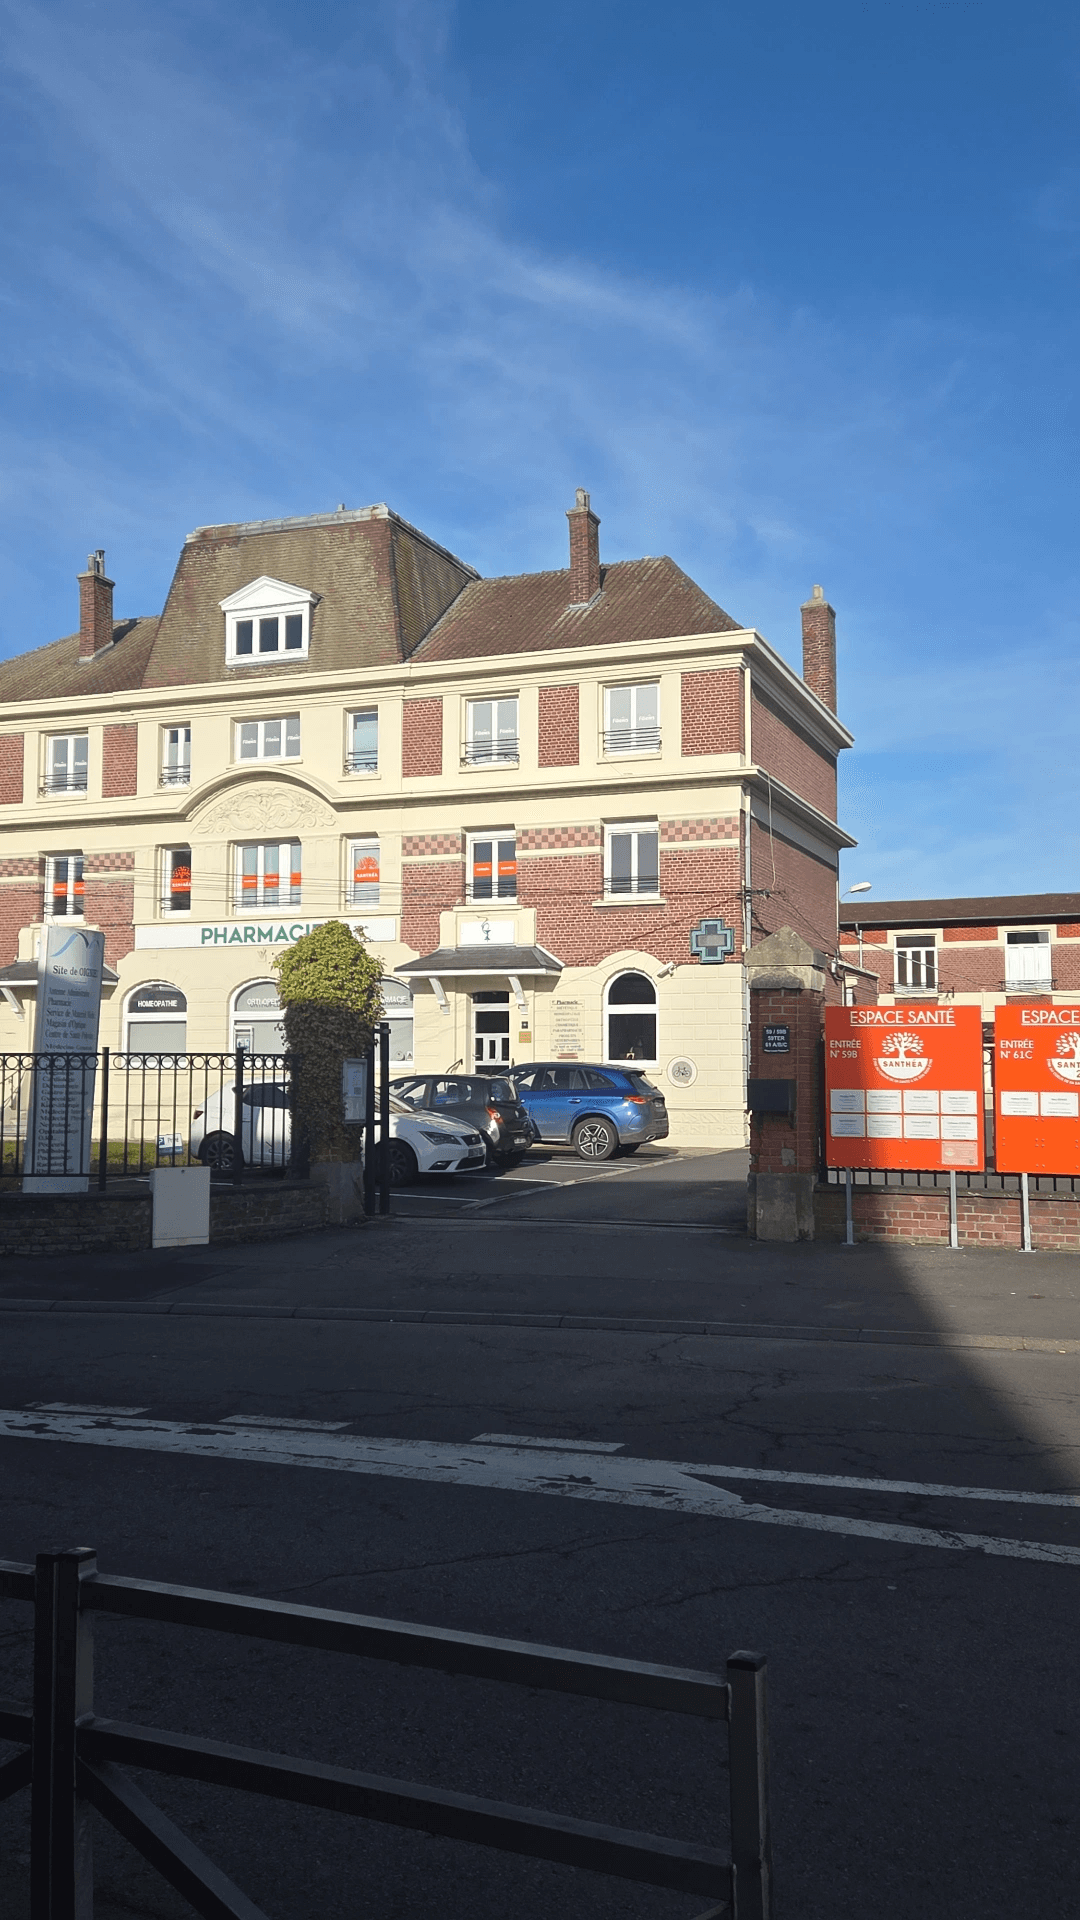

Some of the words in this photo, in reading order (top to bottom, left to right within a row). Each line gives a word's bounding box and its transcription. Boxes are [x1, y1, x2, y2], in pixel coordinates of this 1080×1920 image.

[201, 924, 323, 945] PHARMACI
[52, 964, 68, 975] Site
[70, 966, 78, 976] de
[850, 1010, 904, 1024] ESPACE
[908, 1007, 955, 1024] SANTÉ
[1022, 1010, 1080, 1024] ESPACE
[830, 1038, 862, 1049] ENTRÉE
[1000, 1038, 1034, 1049] ENTRÉE
[842, 1050, 858, 1059] 59B
[1014, 1050, 1033, 1059] 61C
[882, 1058, 923, 1068] SANTHÉA
